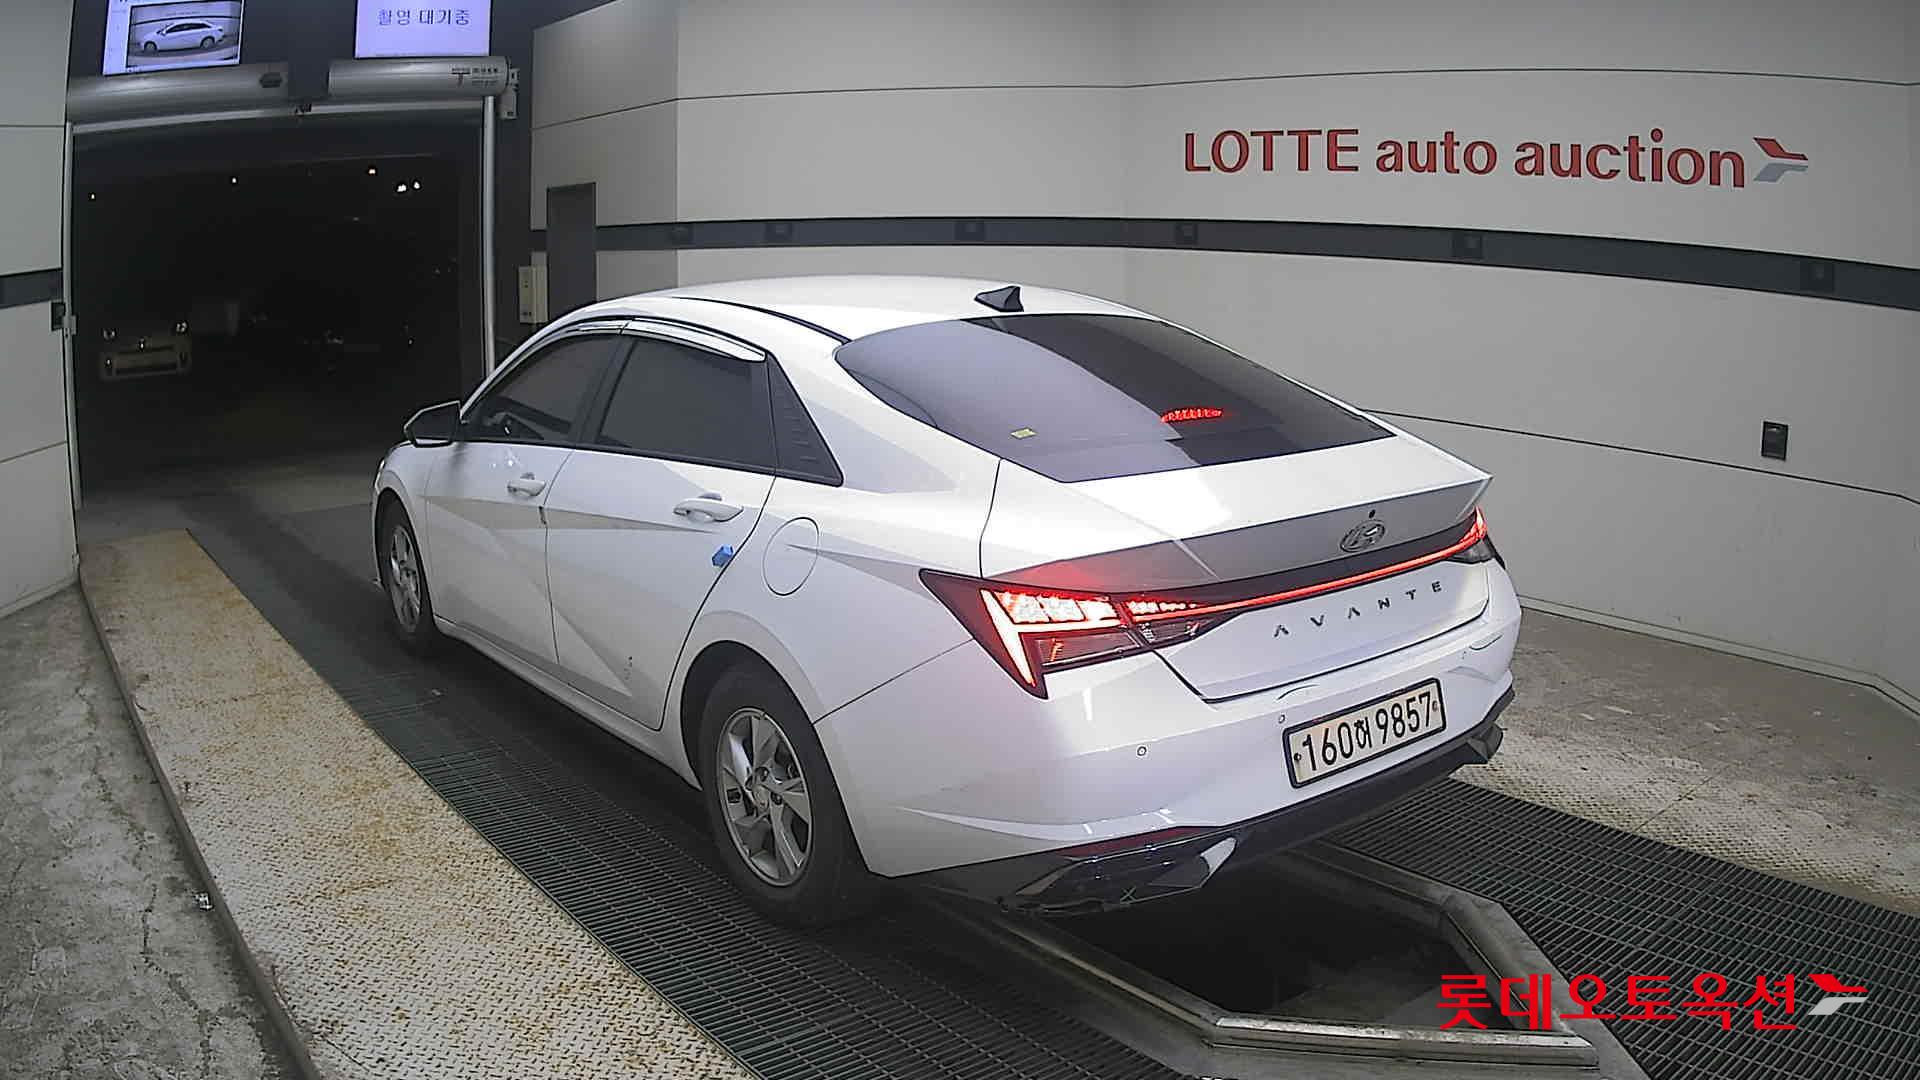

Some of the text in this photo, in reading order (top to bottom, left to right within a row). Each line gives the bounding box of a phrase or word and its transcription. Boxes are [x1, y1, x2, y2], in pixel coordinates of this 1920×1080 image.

[1185, 129, 1746, 188] LOTTE auto auction
[1274, 581, 1443, 638] AVANTE
